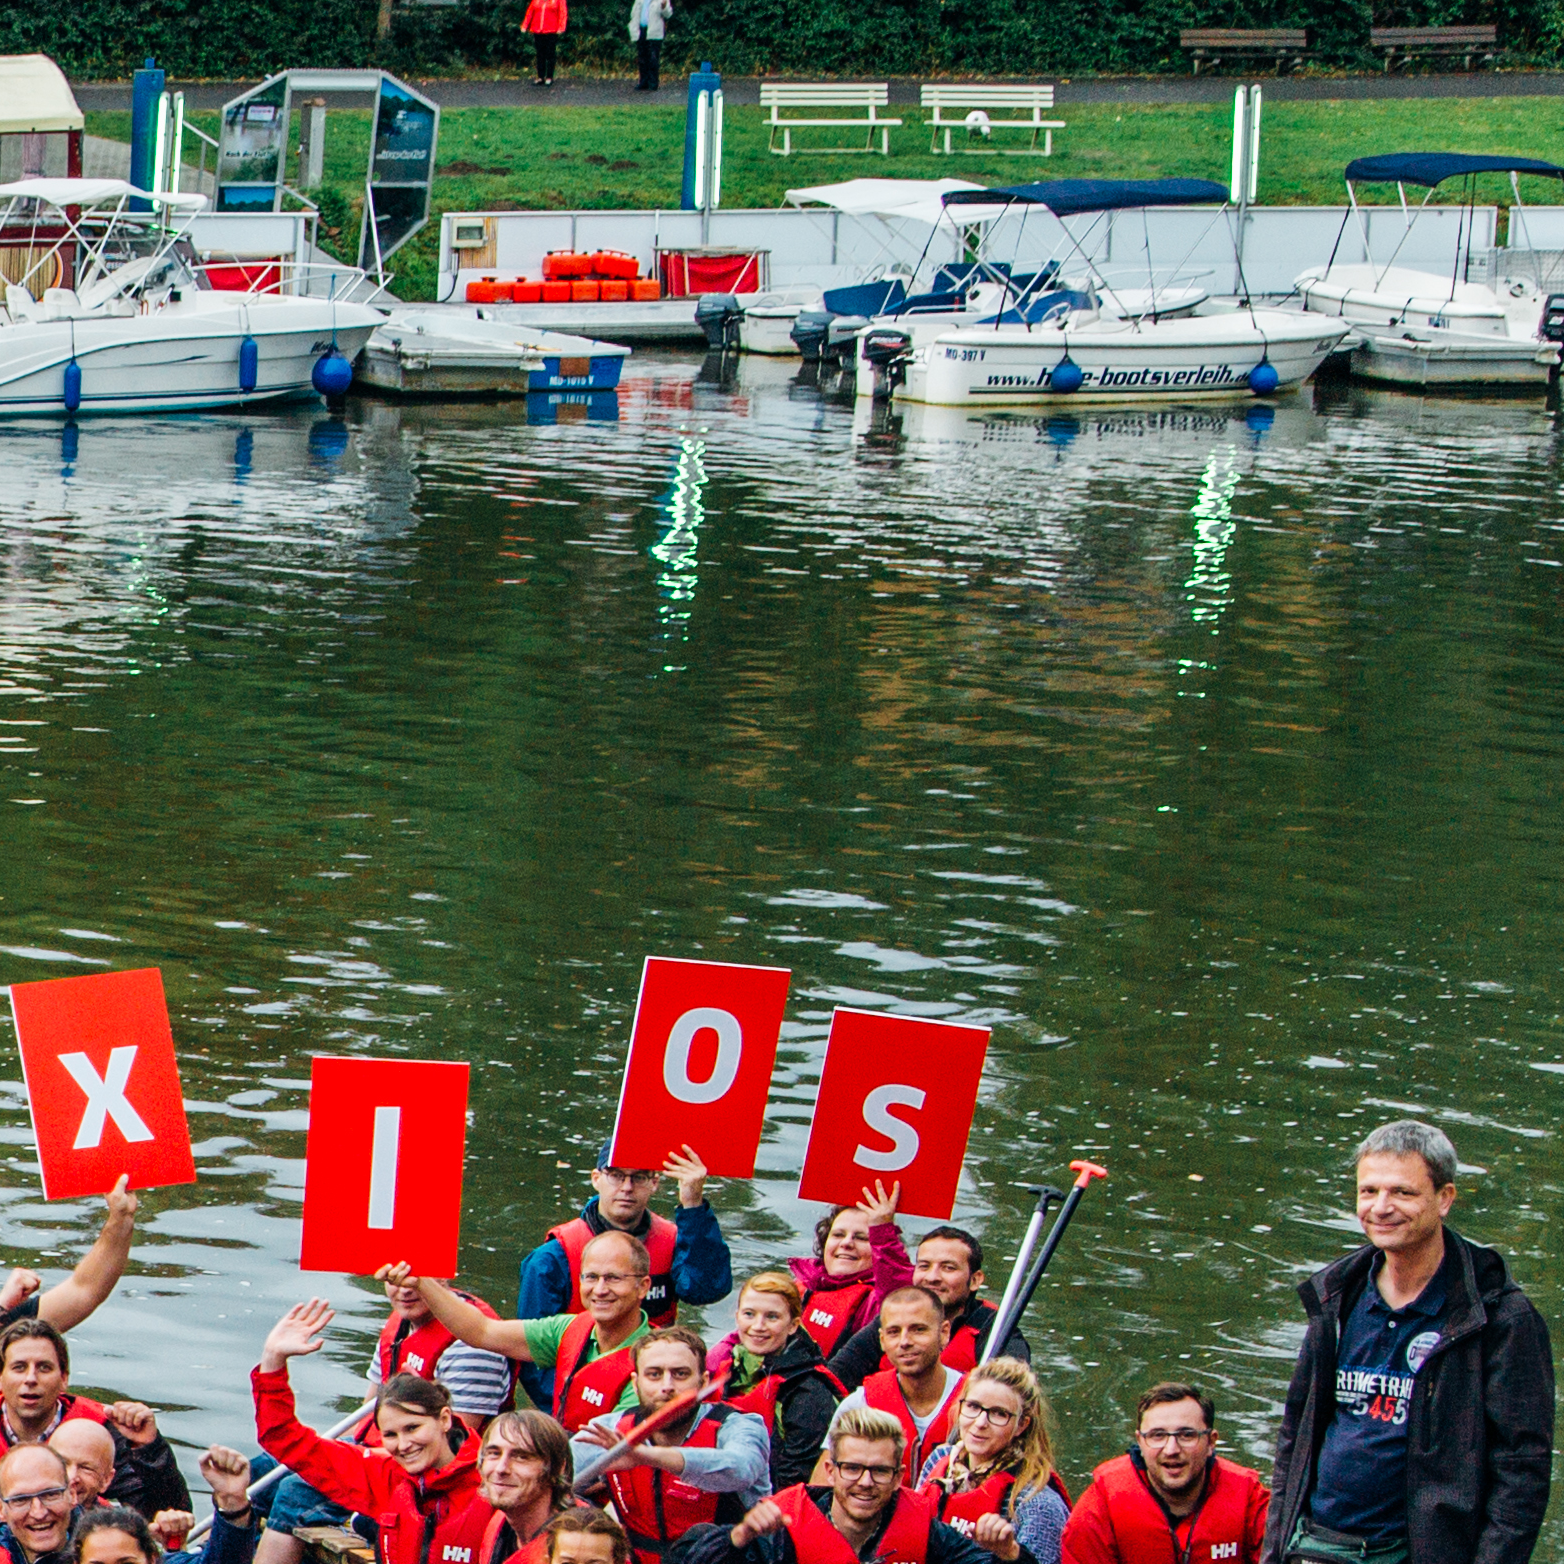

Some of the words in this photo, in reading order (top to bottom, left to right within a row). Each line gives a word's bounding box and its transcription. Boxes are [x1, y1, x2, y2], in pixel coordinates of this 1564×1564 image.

[986, 364, 1250, 387] www.he-bootsverleih.d
[810, 1309, 833, 1328] HH
[582, 1386, 604, 1407] HH
[443, 1544, 471, 1563] HH
[1211, 1542, 1237, 1560] HH
